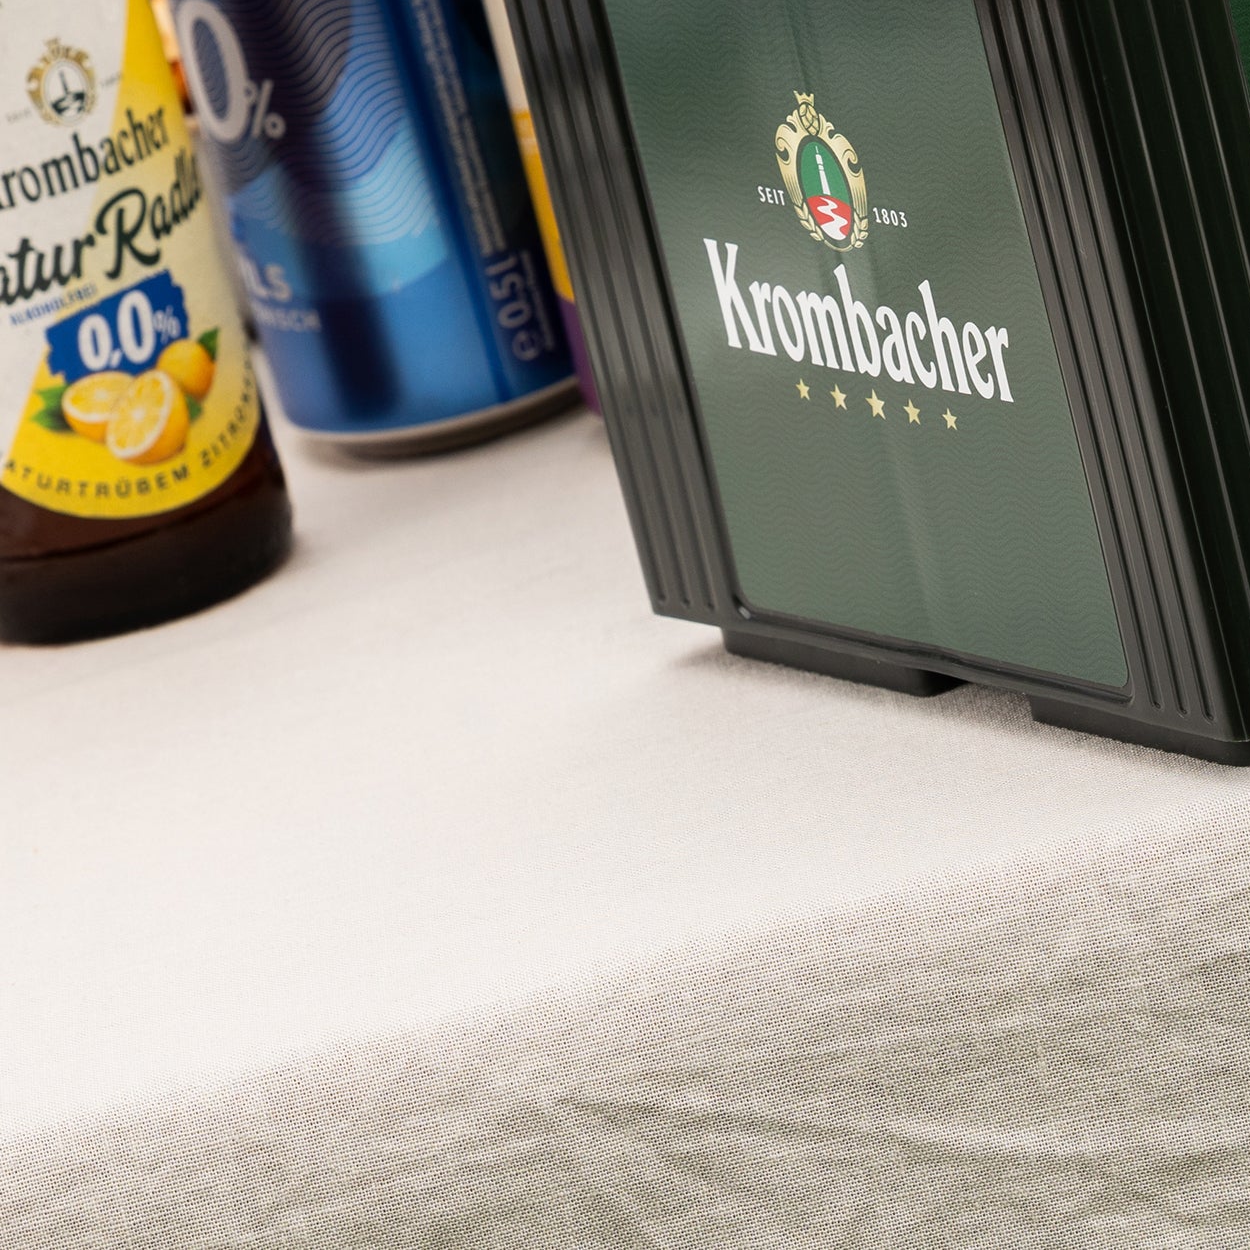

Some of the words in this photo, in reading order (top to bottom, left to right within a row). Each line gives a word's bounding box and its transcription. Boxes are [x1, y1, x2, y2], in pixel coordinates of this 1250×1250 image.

[0, 104, 168, 211] rombacher
[757, 185, 786, 207] SEIT
[873, 206, 908, 228] 1803
[0, 237, 96, 306] atur
[77, 288, 182, 372] 0,0%
[703, 237, 1014, 403] Krombacher
[3, 458, 190, 499] ATURTRÜBEM
